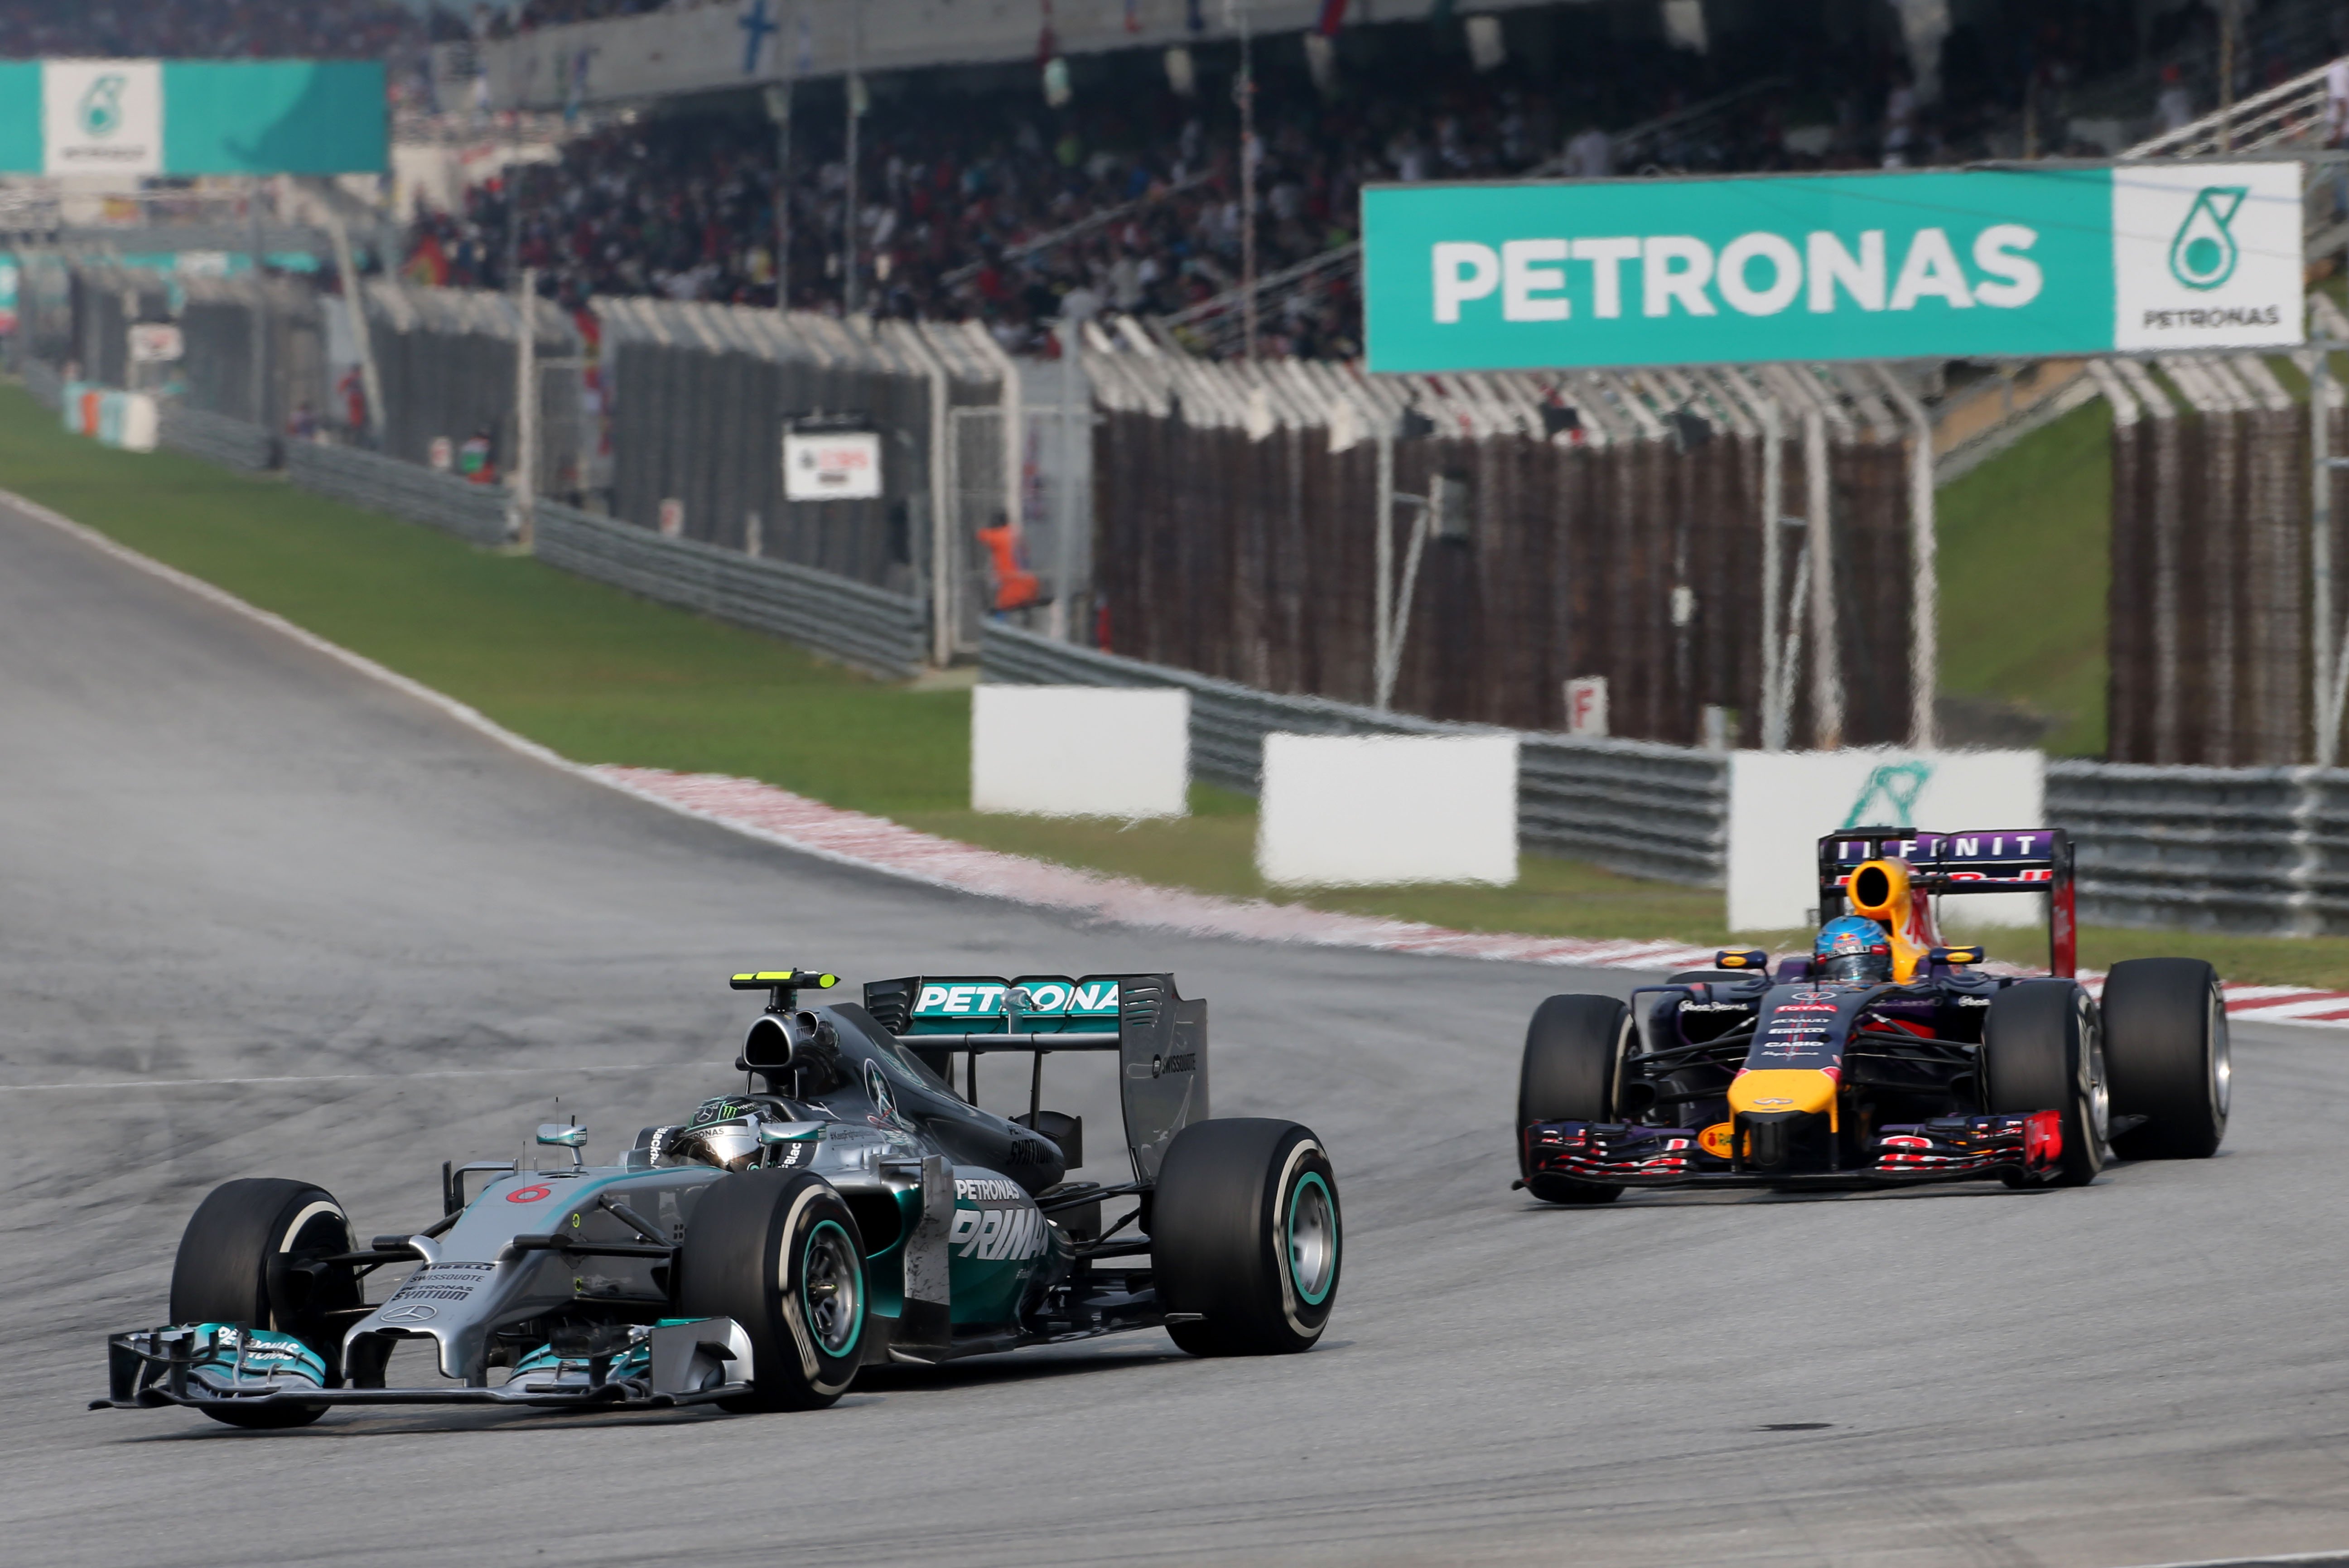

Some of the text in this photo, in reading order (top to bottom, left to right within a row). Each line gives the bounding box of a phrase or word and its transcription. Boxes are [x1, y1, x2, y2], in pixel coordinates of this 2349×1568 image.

[1432, 224, 2042, 323] PETRONAS
[2143, 305, 2280, 329] PETRONAS
[1574, 688, 1595, 728] F
[915, 984, 1119, 1012] PETONA
[506, 1182, 558, 1203] 6
[955, 1179, 1020, 1200] PETRONAS
[420, 1262, 494, 1271] PIRELLI
[410, 1274, 485, 1283] SWISSQUOTE
[391, 1290, 469, 1301] SYNTIUM
